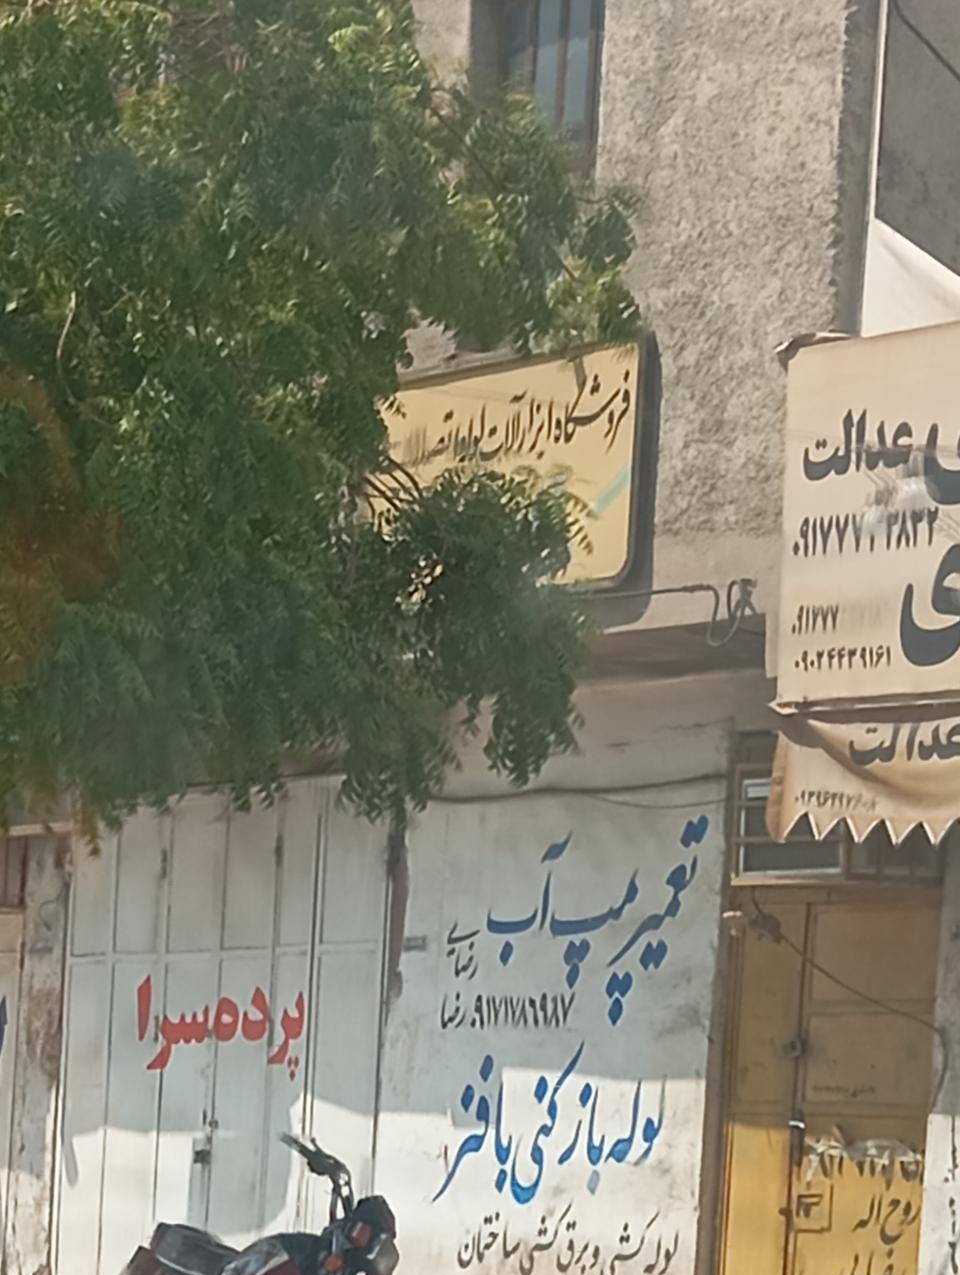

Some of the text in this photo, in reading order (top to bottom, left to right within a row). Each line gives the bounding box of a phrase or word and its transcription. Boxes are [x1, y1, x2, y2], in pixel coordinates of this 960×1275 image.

[554, 365, 632, 452] فروشگاه
[803, 408, 913, 482] عدالت
[487, 814, 709, 1026] تعمیر پمپ آب
[440, 991, 466, 1030] رضا
[431, 1053, 495, 1204] فنر
[605, 1075, 668, 1168] لوله
[456, 1211, 520, 1270] ساختمان
[556, 1219, 591, 1275] برق
